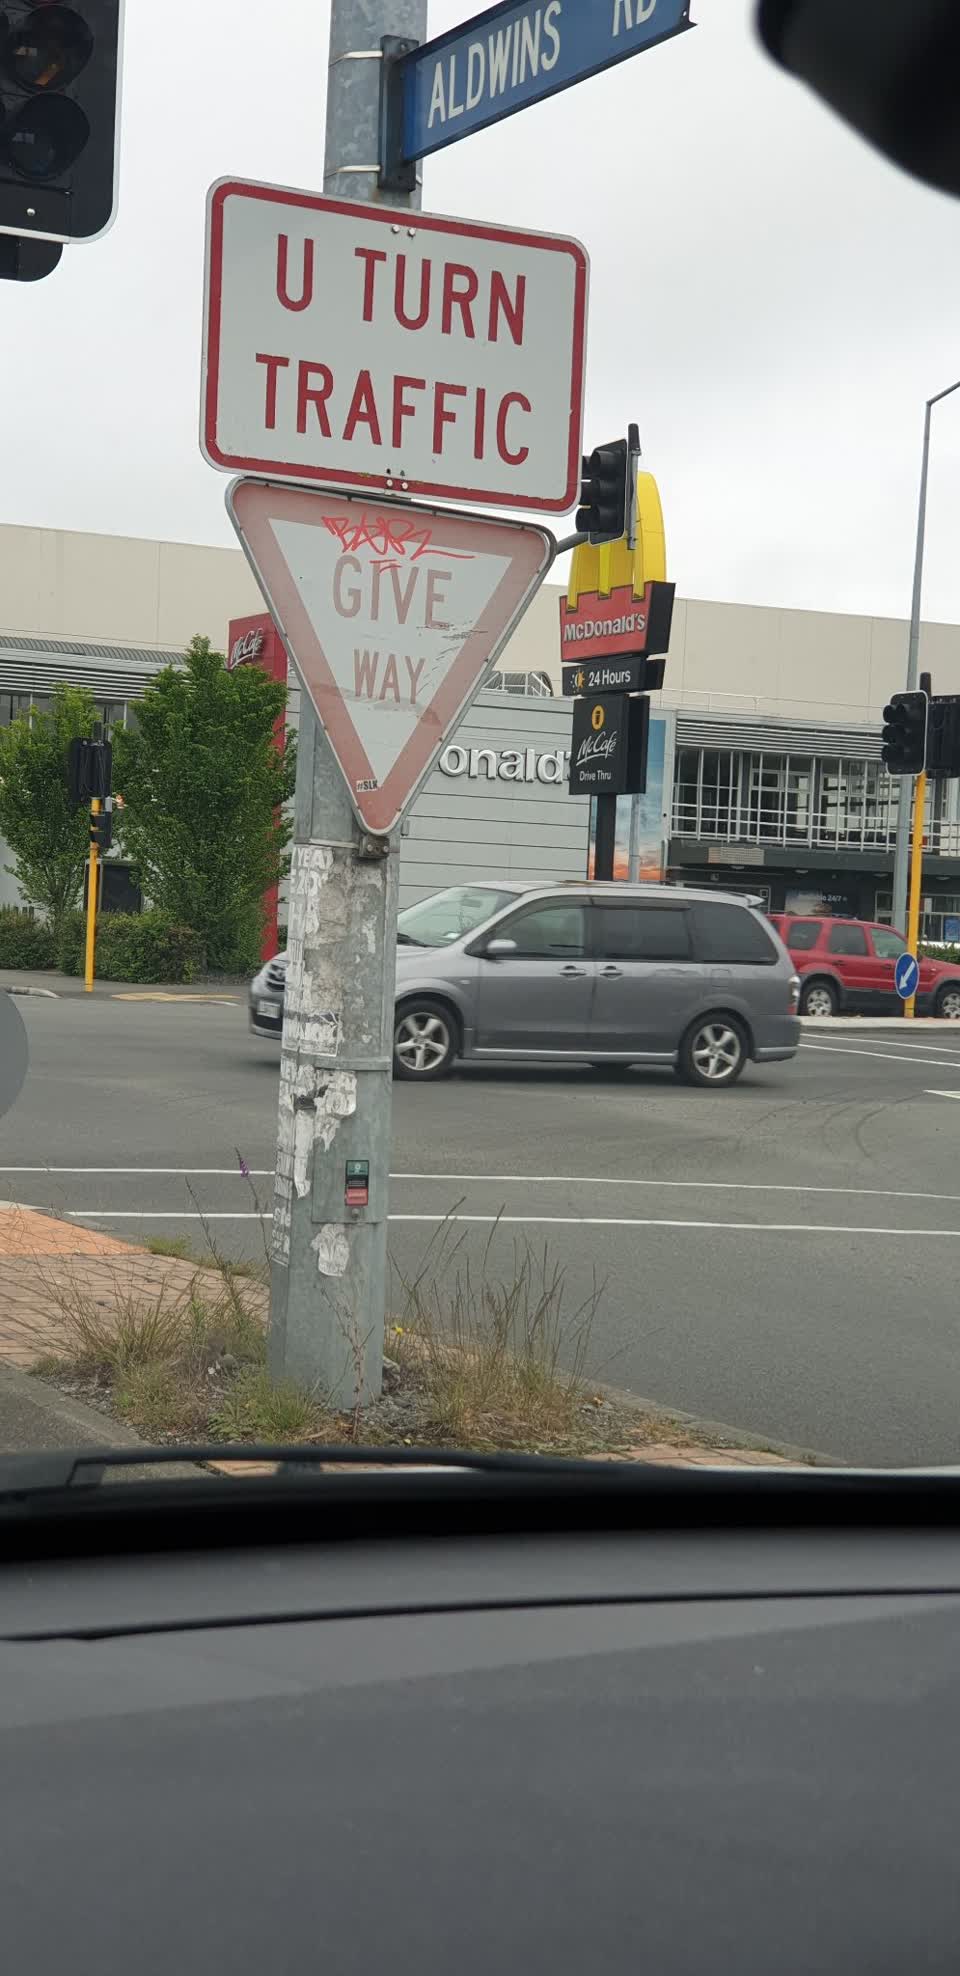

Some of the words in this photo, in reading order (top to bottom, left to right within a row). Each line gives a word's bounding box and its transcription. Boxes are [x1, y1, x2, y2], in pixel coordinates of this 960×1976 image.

[427, 1, 561, 129] ALDWINS
[276, 233, 314, 312] U
[354, 247, 526, 346] TURN
[255, 353, 532, 466] TRAFFIC
[332, 554, 452, 629] GIVE
[563, 613, 646, 642] McDonald's
[353, 648, 425, 705] WAY
[588, 671, 600, 687] 24
[601, 669, 631, 686] Hours
[439, 744, 571, 785] onald'
[576, 730, 618, 763] McCafé
[579, 770, 596, 782] Drive
[597, 769, 612, 780] Thru
